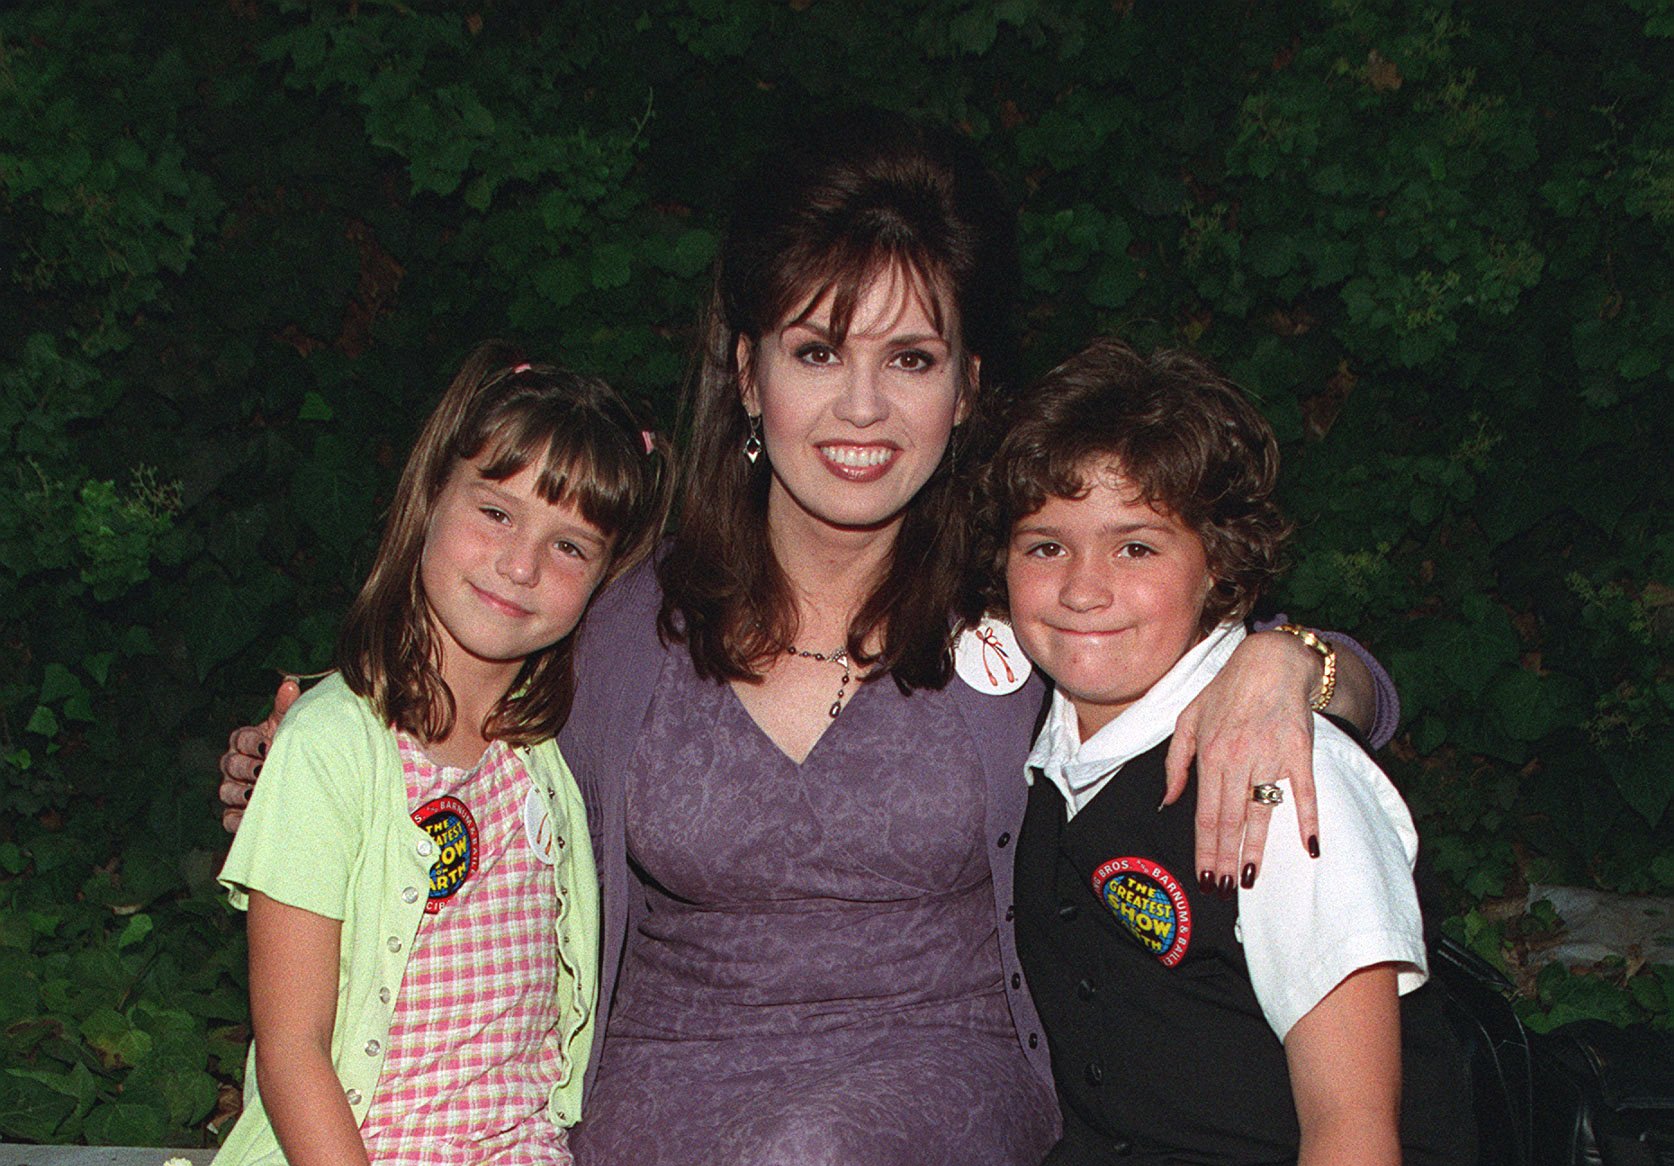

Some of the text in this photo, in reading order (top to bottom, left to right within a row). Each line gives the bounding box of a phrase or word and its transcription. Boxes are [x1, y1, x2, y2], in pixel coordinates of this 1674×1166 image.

[425, 819, 450, 834] THE
[440, 801, 472, 826] BARNUM
[434, 821, 463, 847] ATEST
[441, 835, 468, 865] OW
[430, 864, 467, 890] ARTH
[1127, 877, 1157, 898] THE
[1109, 879, 1173, 918] GREATEST
[1151, 867, 1188, 923] BARNUM
[1179, 925, 1189, 934] &
[1107, 893, 1172, 938] SHOW
